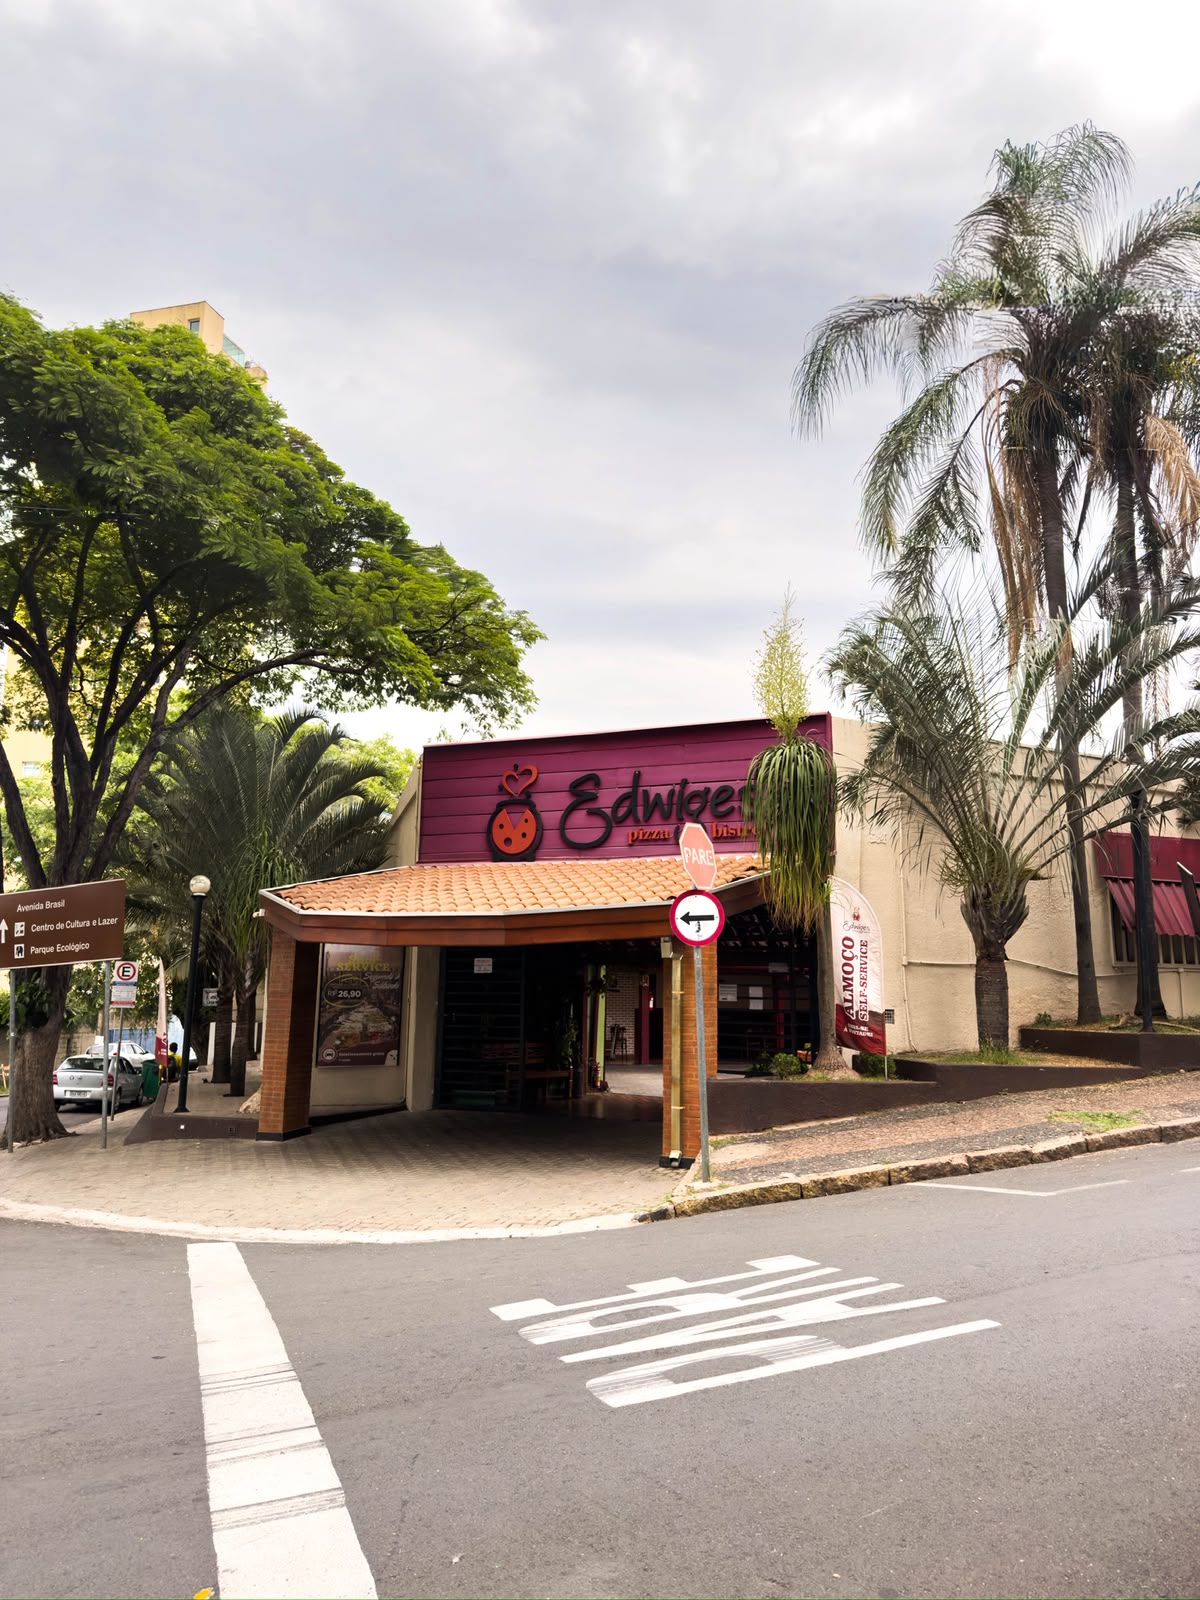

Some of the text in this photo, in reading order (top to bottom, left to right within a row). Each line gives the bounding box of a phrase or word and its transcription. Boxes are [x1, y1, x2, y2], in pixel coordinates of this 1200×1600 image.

[628, 825, 671, 845] pizza
[683, 847, 714, 867] PARE
[16, 899, 65, 913] Avenida Brasil
[31, 923, 54, 932] Centro
[55, 922, 65, 930] de
[65, 919, 90, 929] Cultura
[98, 917, 118, 926] Lazer
[30, 942, 90, 955] Parque Ecológico
[122, 966, 131, 977] E
[336, 962, 391, 971] SERVICE
[841, 935, 858, 1018] ALMOÇO
[859, 940, 868, 1021] SELF-SERVICE
